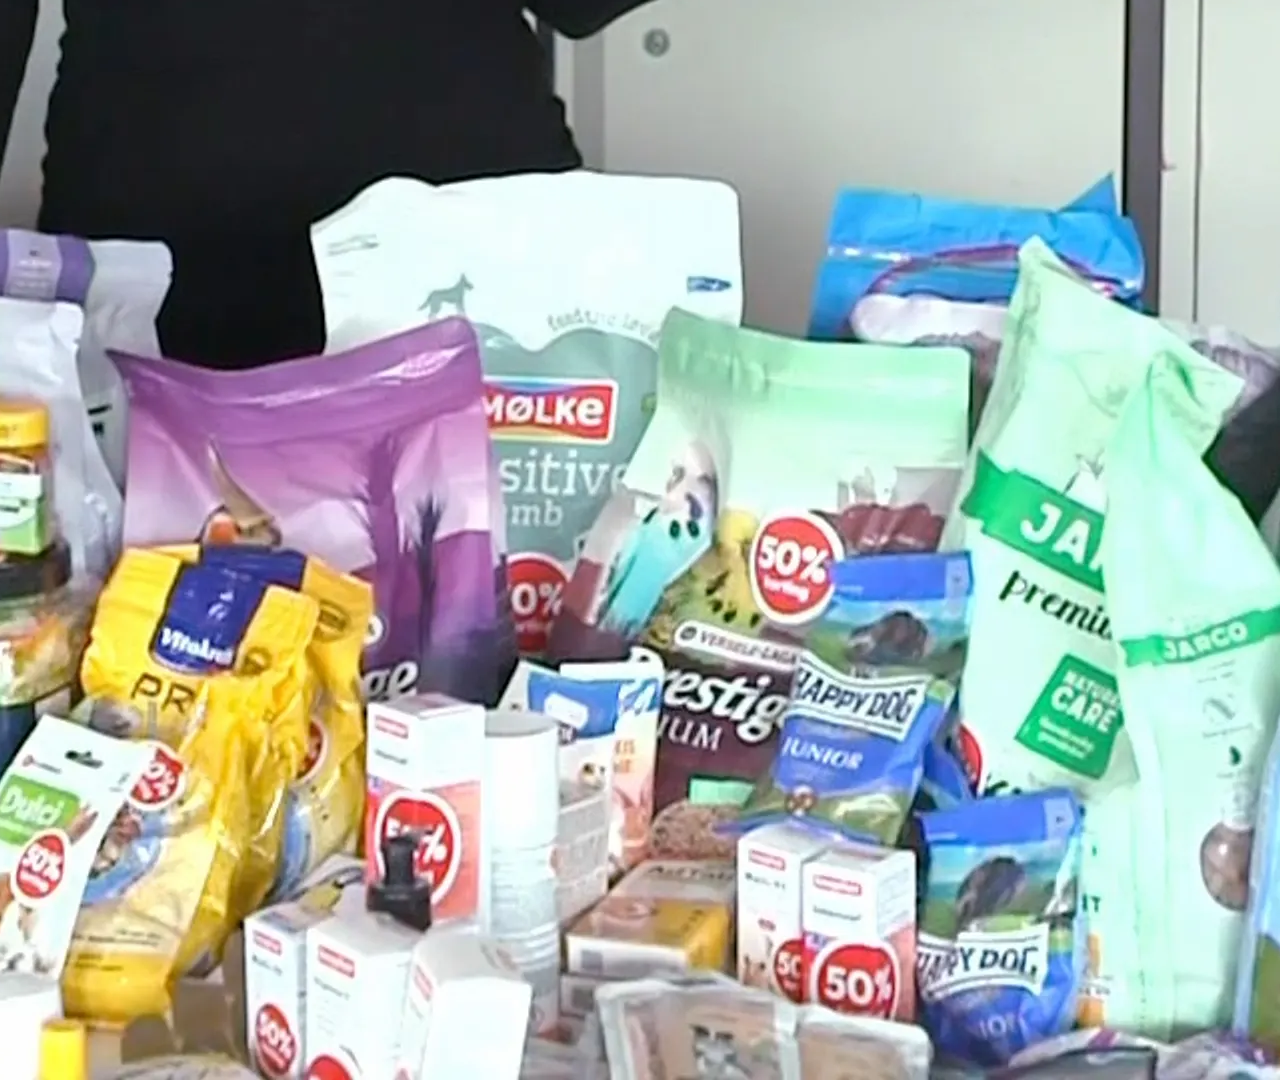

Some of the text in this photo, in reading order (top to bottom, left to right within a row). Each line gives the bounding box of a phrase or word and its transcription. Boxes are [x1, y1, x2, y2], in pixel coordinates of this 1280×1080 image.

[759, 535, 829, 585] 50%
[998, 570, 1113, 641] premiu
[1163, 622, 1248, 660] JARCO
[868, 683, 918, 721] DOG
[1051, 685, 1118, 733] CARE
[782, 737, 864, 769] JUNIOR
[824, 963, 892, 1006] 50%
